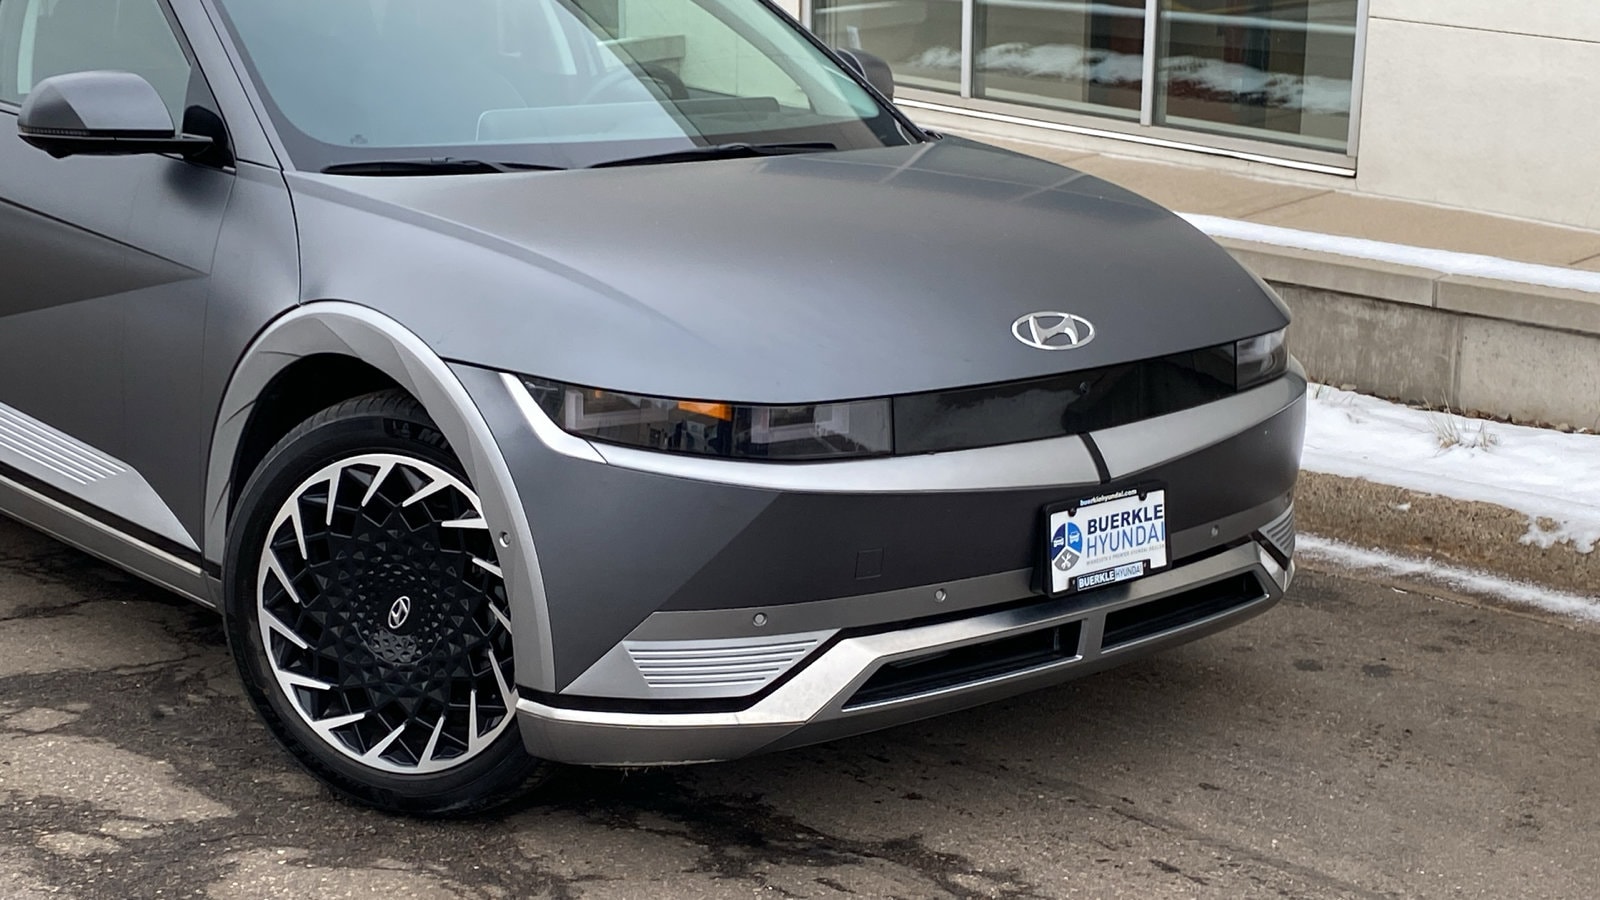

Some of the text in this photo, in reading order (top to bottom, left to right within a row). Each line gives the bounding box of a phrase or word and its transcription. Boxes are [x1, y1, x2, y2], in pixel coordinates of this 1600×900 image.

[1087, 504, 1163, 535] BUERKLE
[1086, 521, 1165, 558] HYUNDAI
[1078, 570, 1115, 589] BUERKLE
